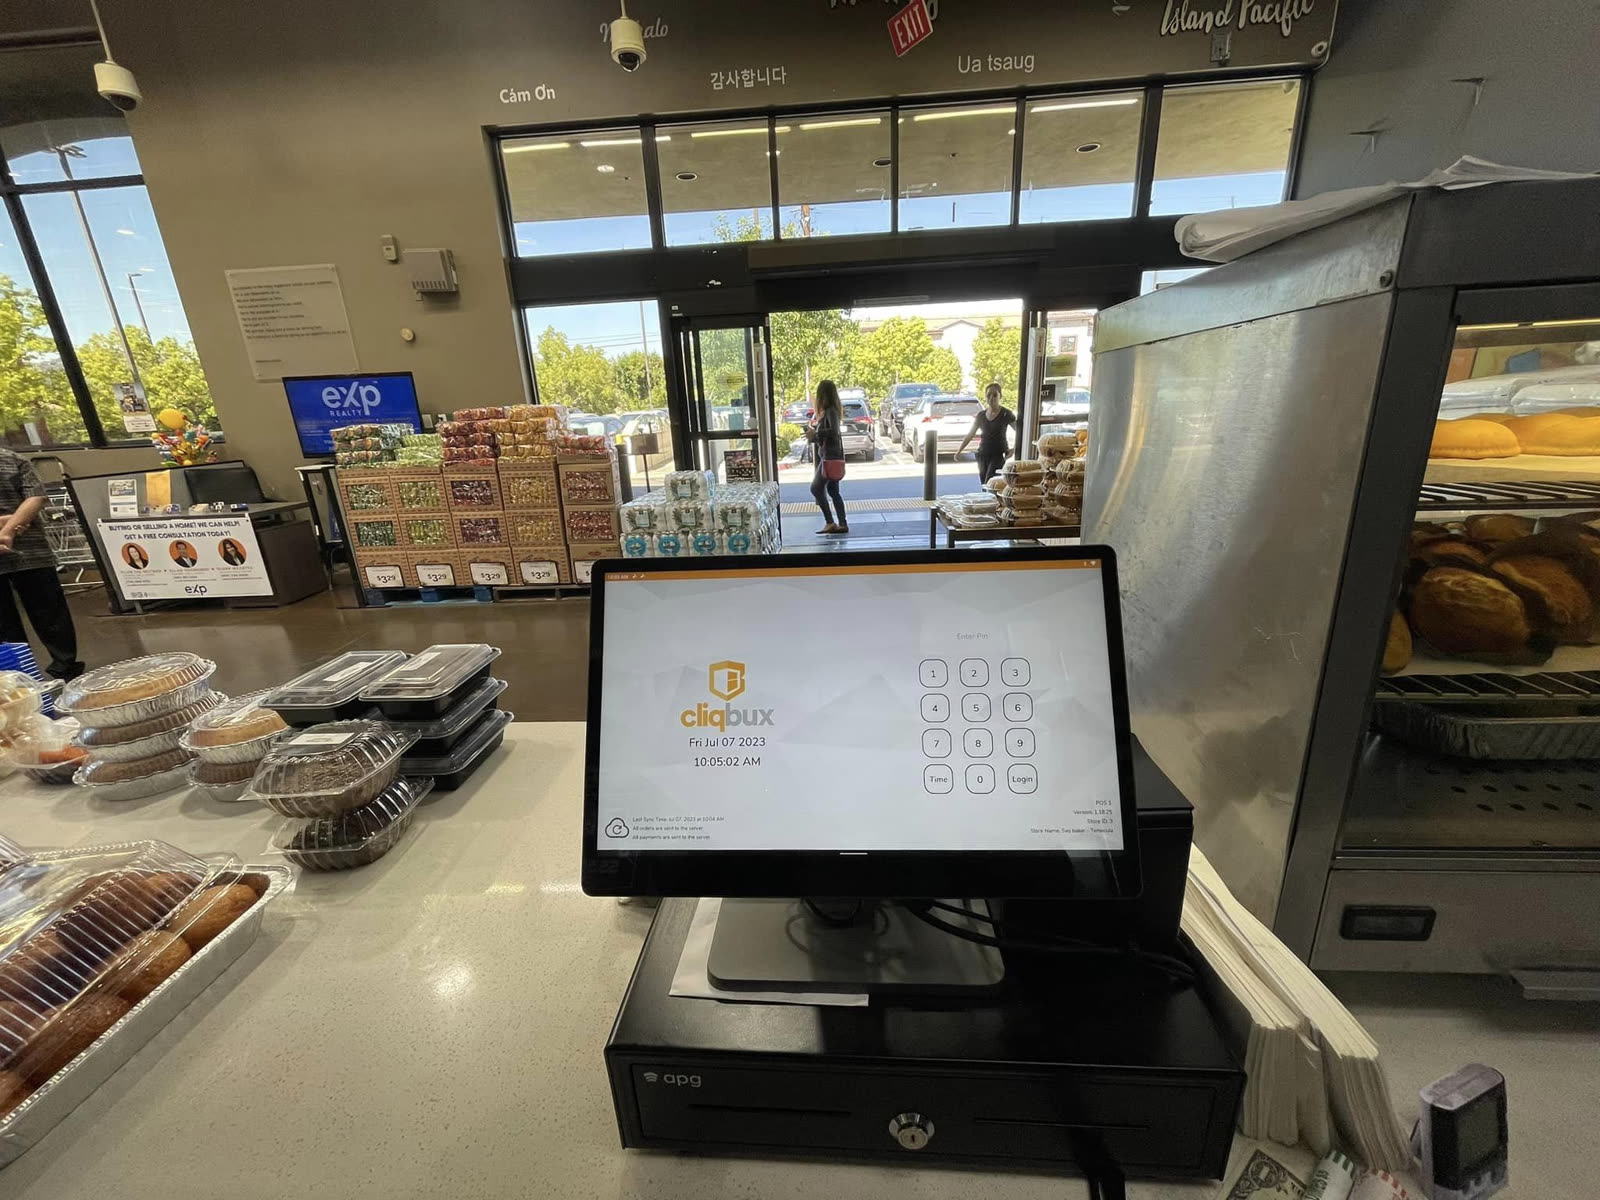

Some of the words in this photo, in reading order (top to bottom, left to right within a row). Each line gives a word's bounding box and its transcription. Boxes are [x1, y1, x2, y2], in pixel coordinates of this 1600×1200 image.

[1160, 0, 1234, 35] Island
[894, 4, 925, 48] EXIT
[957, 55, 982, 73] Ua
[987, 54, 1035, 73] tsaug
[709, 65, 787, 90] 감사합니다
[499, 87, 531, 104] Cám
[329, 409, 362, 417] REALTY
[158, 531, 206, 539] CONSULTATION
[956, 632, 976, 640] Enter
[976, 632, 989, 640] Pin
[930, 670, 937, 678] 1
[971, 669, 977, 678] 2
[1012, 669, 1019, 677] 3
[932, 705, 938, 713] 4
[973, 704, 980, 712] 5
[1014, 704, 1021, 712] 6
[680, 702, 775, 732] cliqbux
[689, 738, 702, 747] Fri
[705, 738, 719, 747] Jul
[722, 738, 735, 746] 07
[739, 737, 766, 747] 2023
[933, 740, 940, 748] 7
[975, 740, 982, 748] 8
[1017, 739, 1024, 748] 9
[694, 757, 739, 767] 10:05:02
[743, 757, 761, 766] AM
[977, 776, 983, 784] 0
[1012, 775, 1033, 784] Login
[662, 1072, 702, 1088] apg
